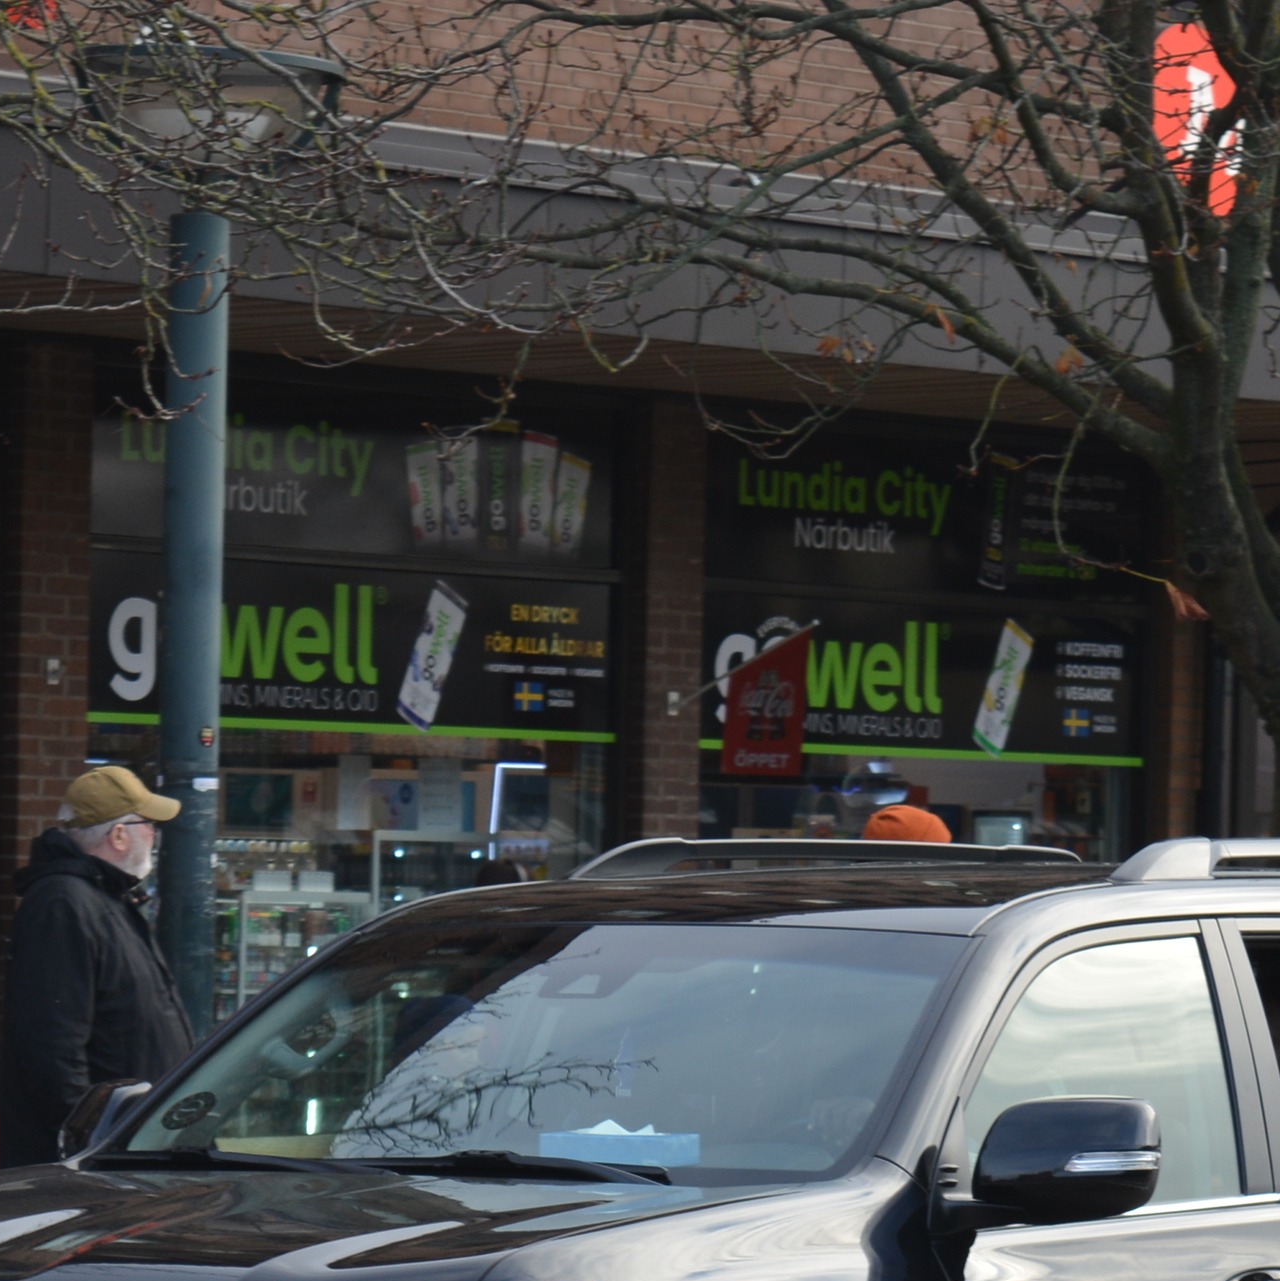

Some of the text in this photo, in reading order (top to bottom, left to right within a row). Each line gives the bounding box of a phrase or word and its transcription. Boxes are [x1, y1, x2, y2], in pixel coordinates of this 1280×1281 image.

[121, 409, 376, 497] Luia City
[738, 458, 952, 537] Lundia City
[793, 516, 895, 554] Närbutik
[107, 583, 380, 701] gwell
[254, 685, 330, 711] MINERALS
[733, 748, 790, 769] ÖPPET
